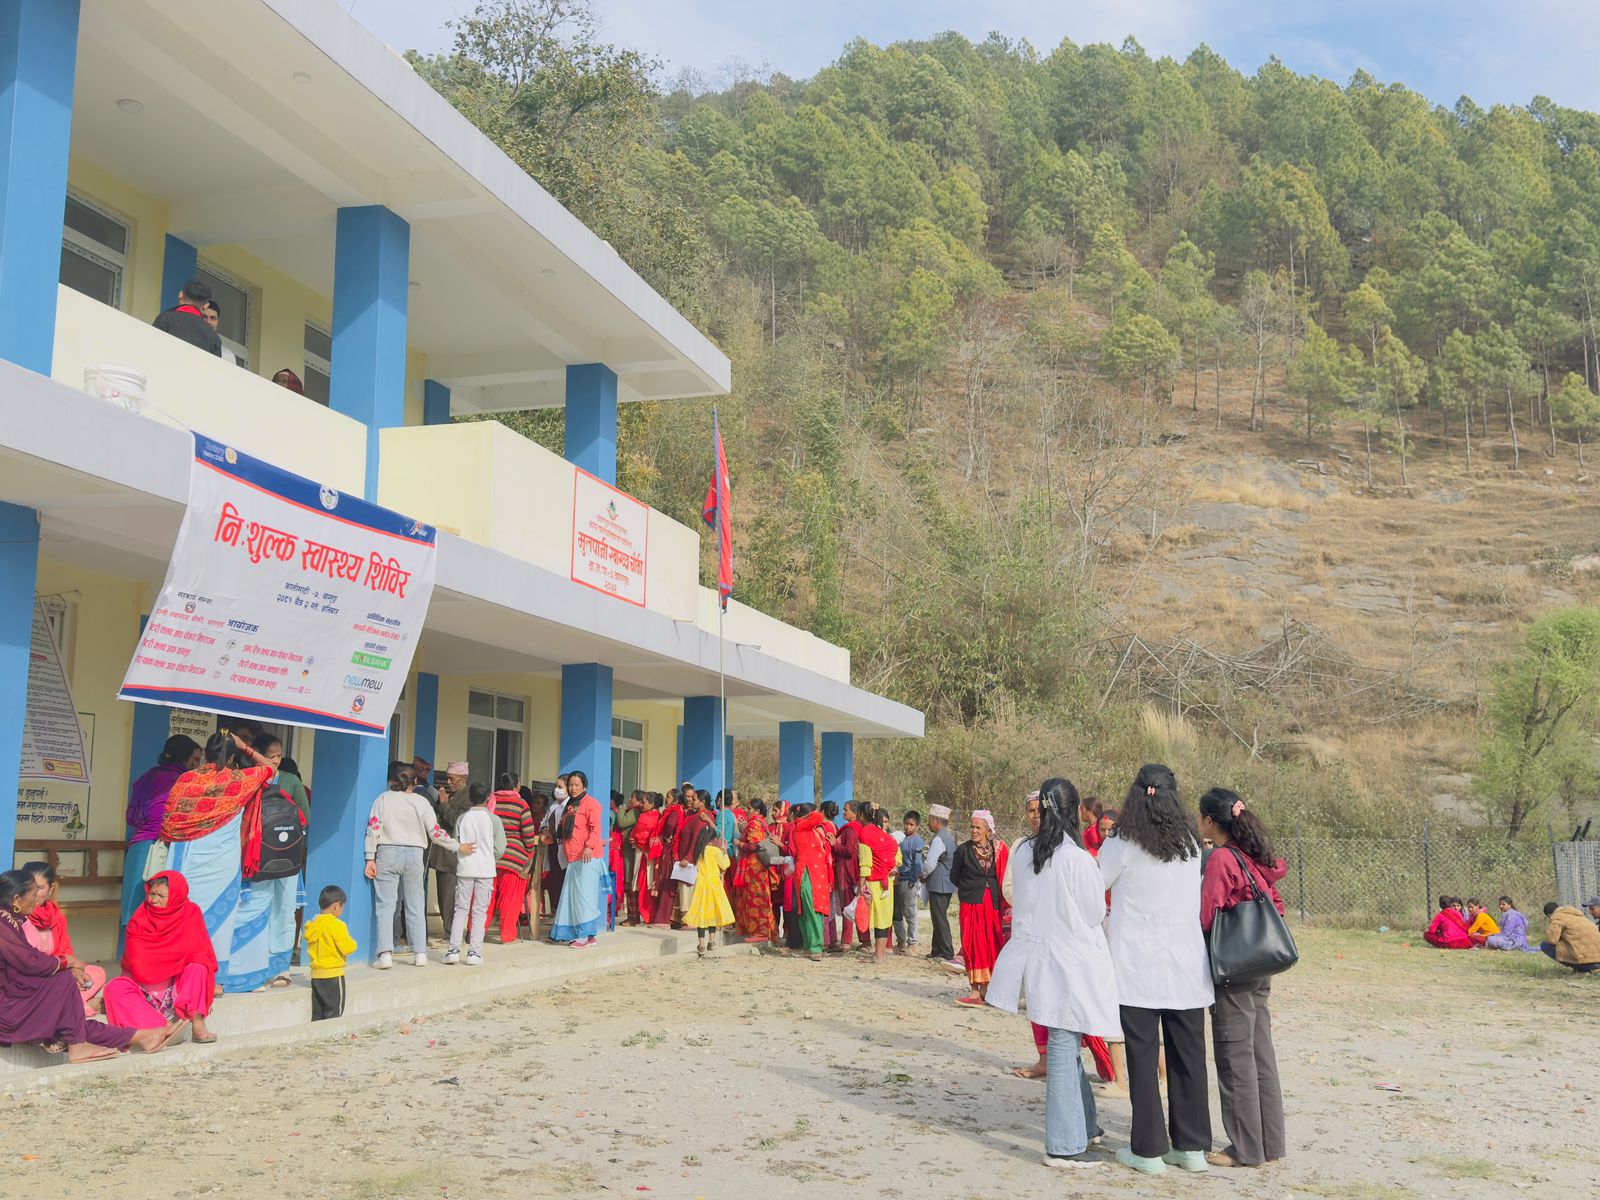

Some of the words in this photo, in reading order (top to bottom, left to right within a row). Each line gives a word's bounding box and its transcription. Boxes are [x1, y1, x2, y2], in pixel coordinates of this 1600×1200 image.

[302, 539, 364, 583] स्वास्थ्य
[363, 551, 411, 599] शिविर
[227, 618, 260, 633] आयोजक
